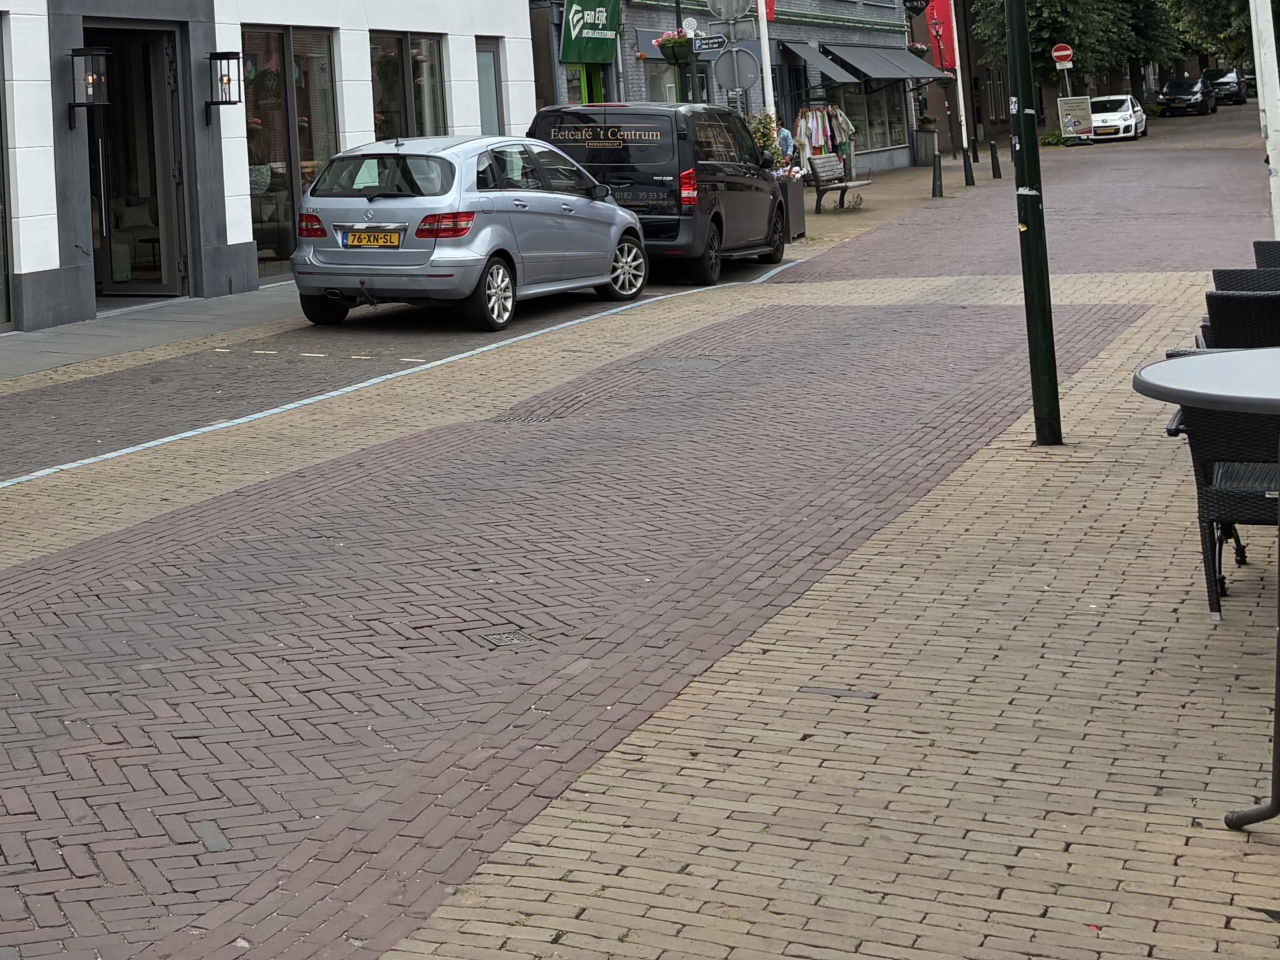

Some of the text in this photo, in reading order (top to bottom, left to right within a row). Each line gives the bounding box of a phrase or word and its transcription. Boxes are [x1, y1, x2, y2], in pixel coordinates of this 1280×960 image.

[584, 10, 595, 23] van
[551, 128, 593, 140] Eetcafé
[608, 128, 661, 140] Centrum
[350, 234, 395, 244] 76-XN-SL
